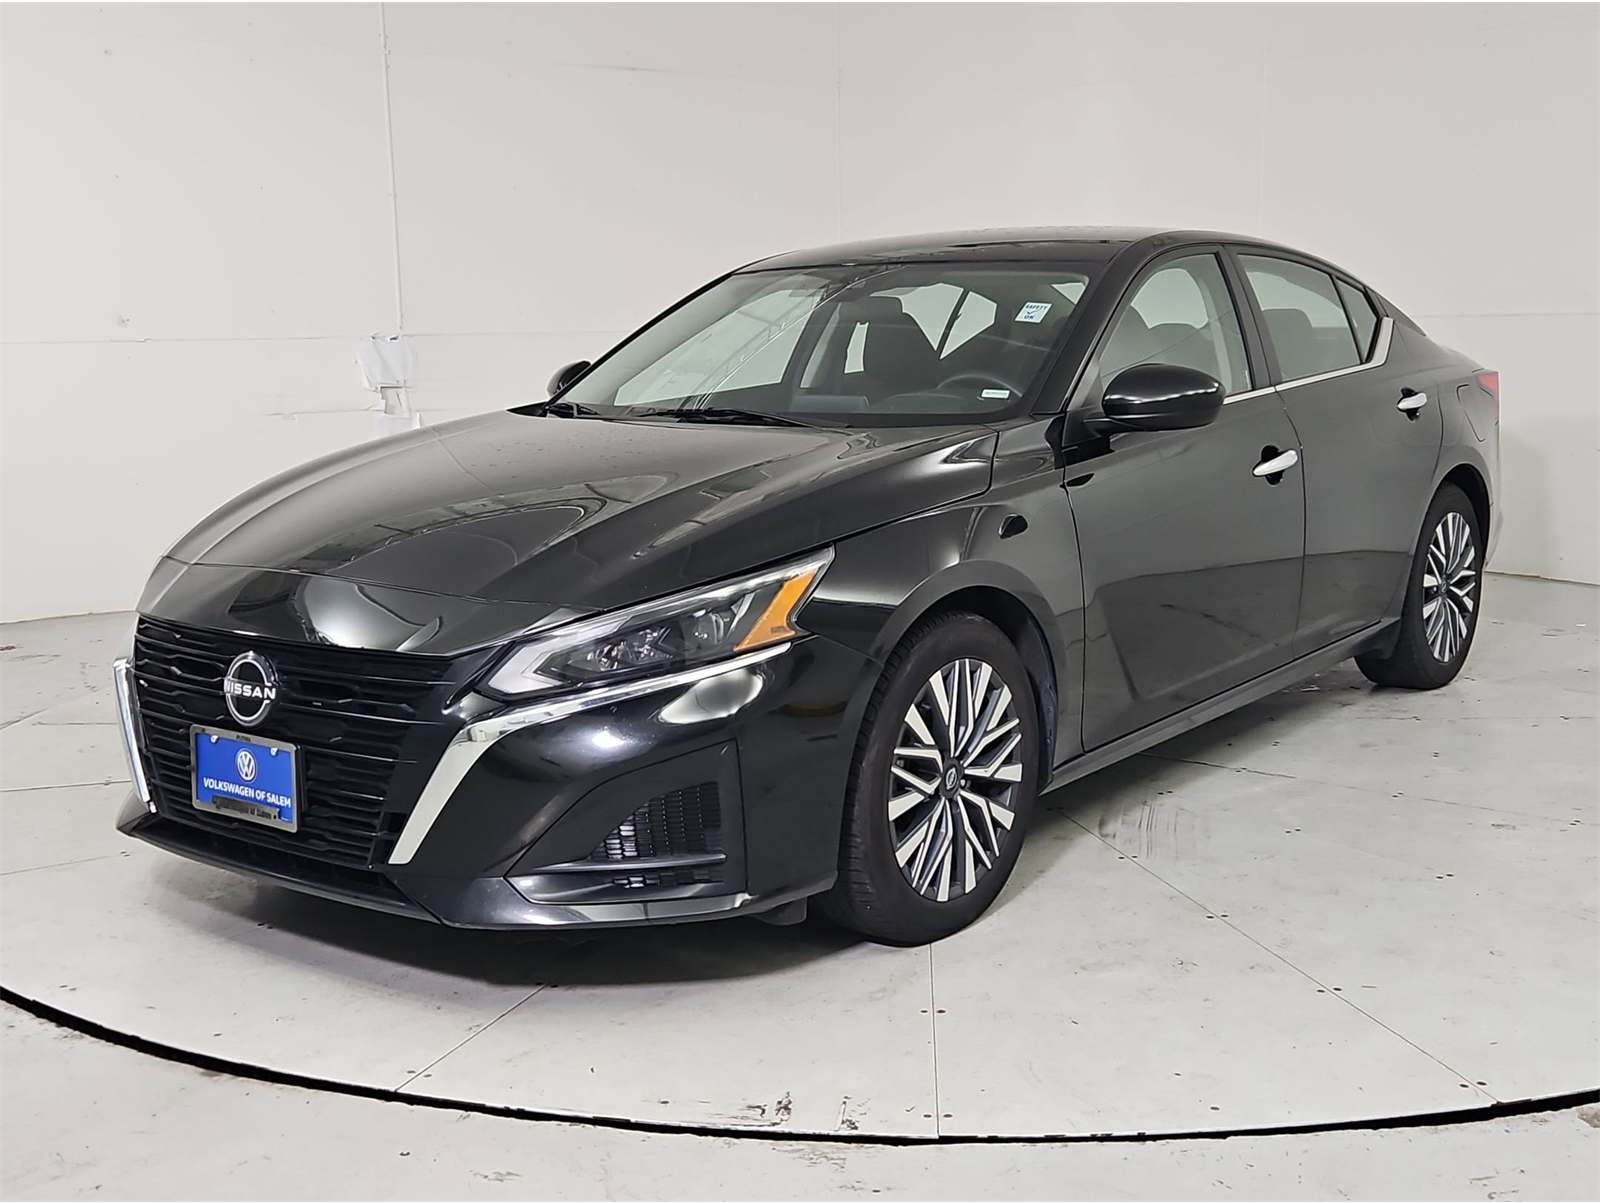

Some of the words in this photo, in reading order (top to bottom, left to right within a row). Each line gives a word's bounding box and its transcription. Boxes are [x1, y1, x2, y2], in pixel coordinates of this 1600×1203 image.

[224, 679, 276, 699] NISSAN
[203, 777, 254, 798] VOLKSWAGEN
[255, 790, 266, 801] OF
[266, 792, 292, 808] SALEM
